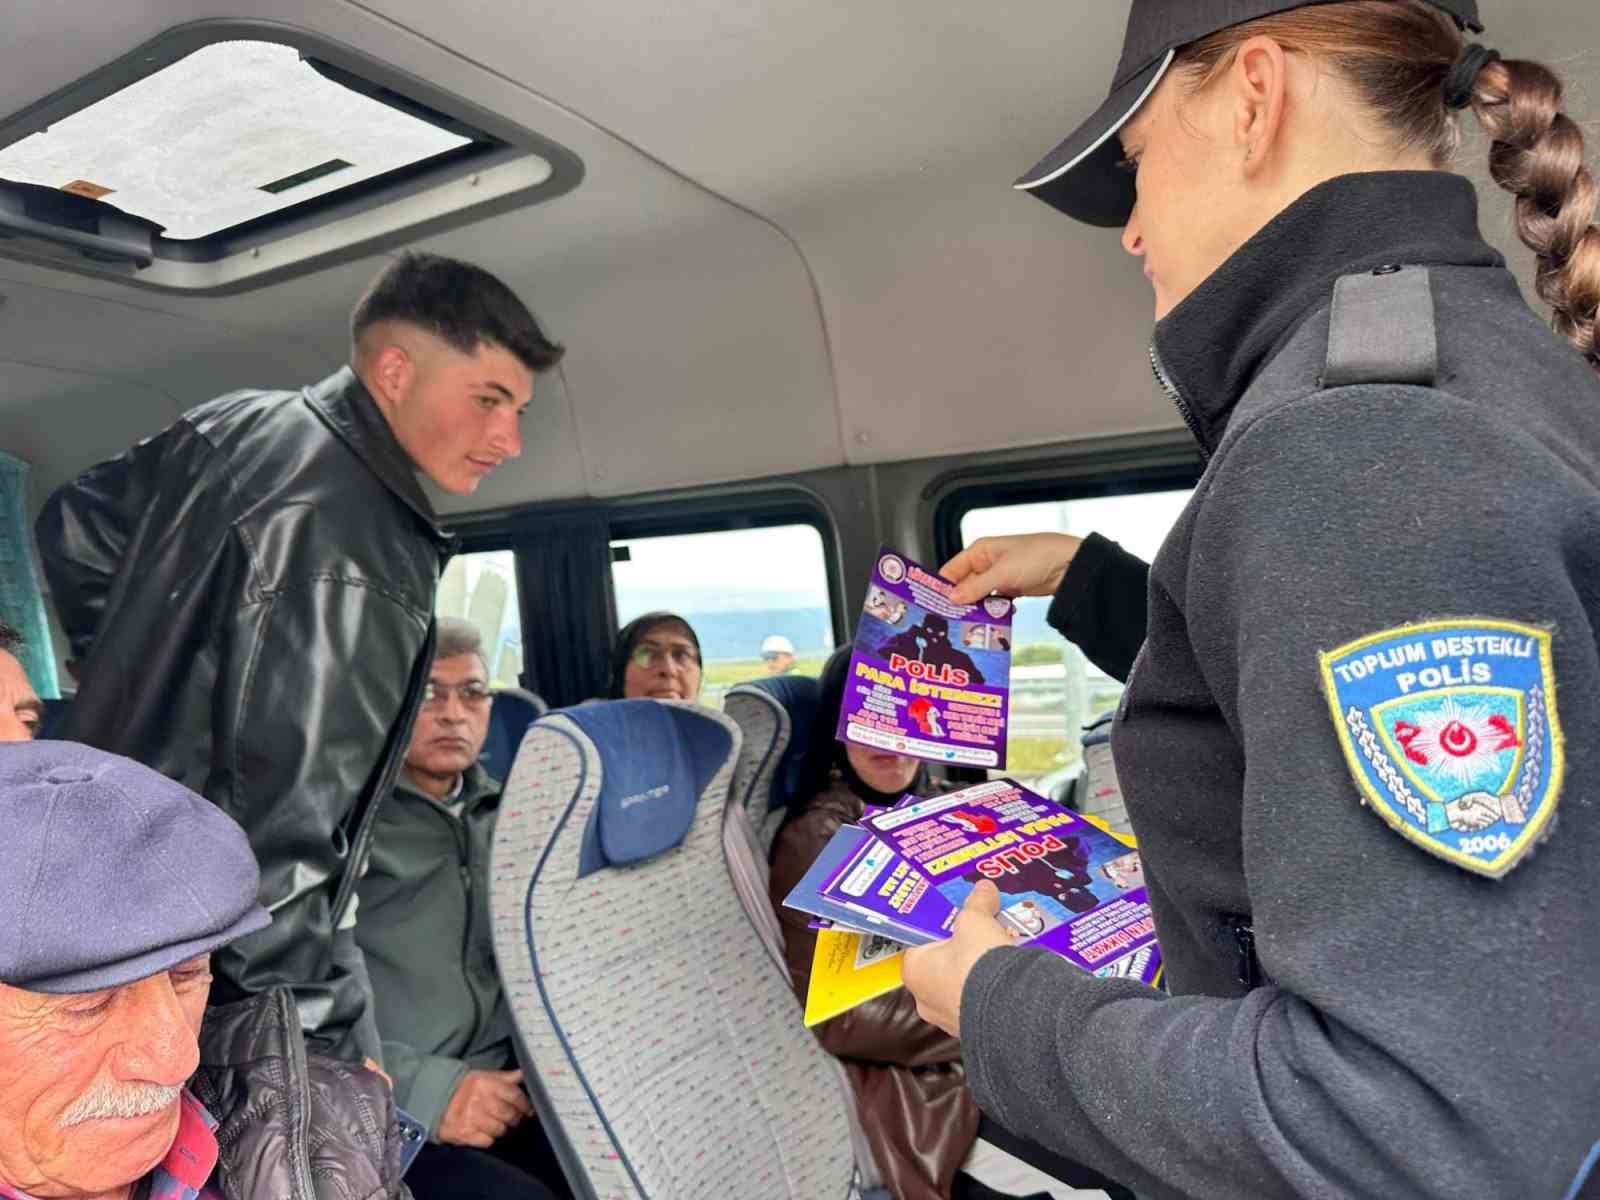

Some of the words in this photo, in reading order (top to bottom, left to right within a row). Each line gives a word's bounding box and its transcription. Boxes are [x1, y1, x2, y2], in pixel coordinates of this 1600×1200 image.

[889, 653, 970, 687] POLİS
[1334, 642, 1427, 683] TOPLUM
[1431, 635, 1536, 660] DESTEKLİ
[1395, 658, 1492, 694] POLİS
[855, 662, 907, 692] PARA
[975, 833, 1068, 879] POLİS
[1458, 831, 1512, 853] 2006
